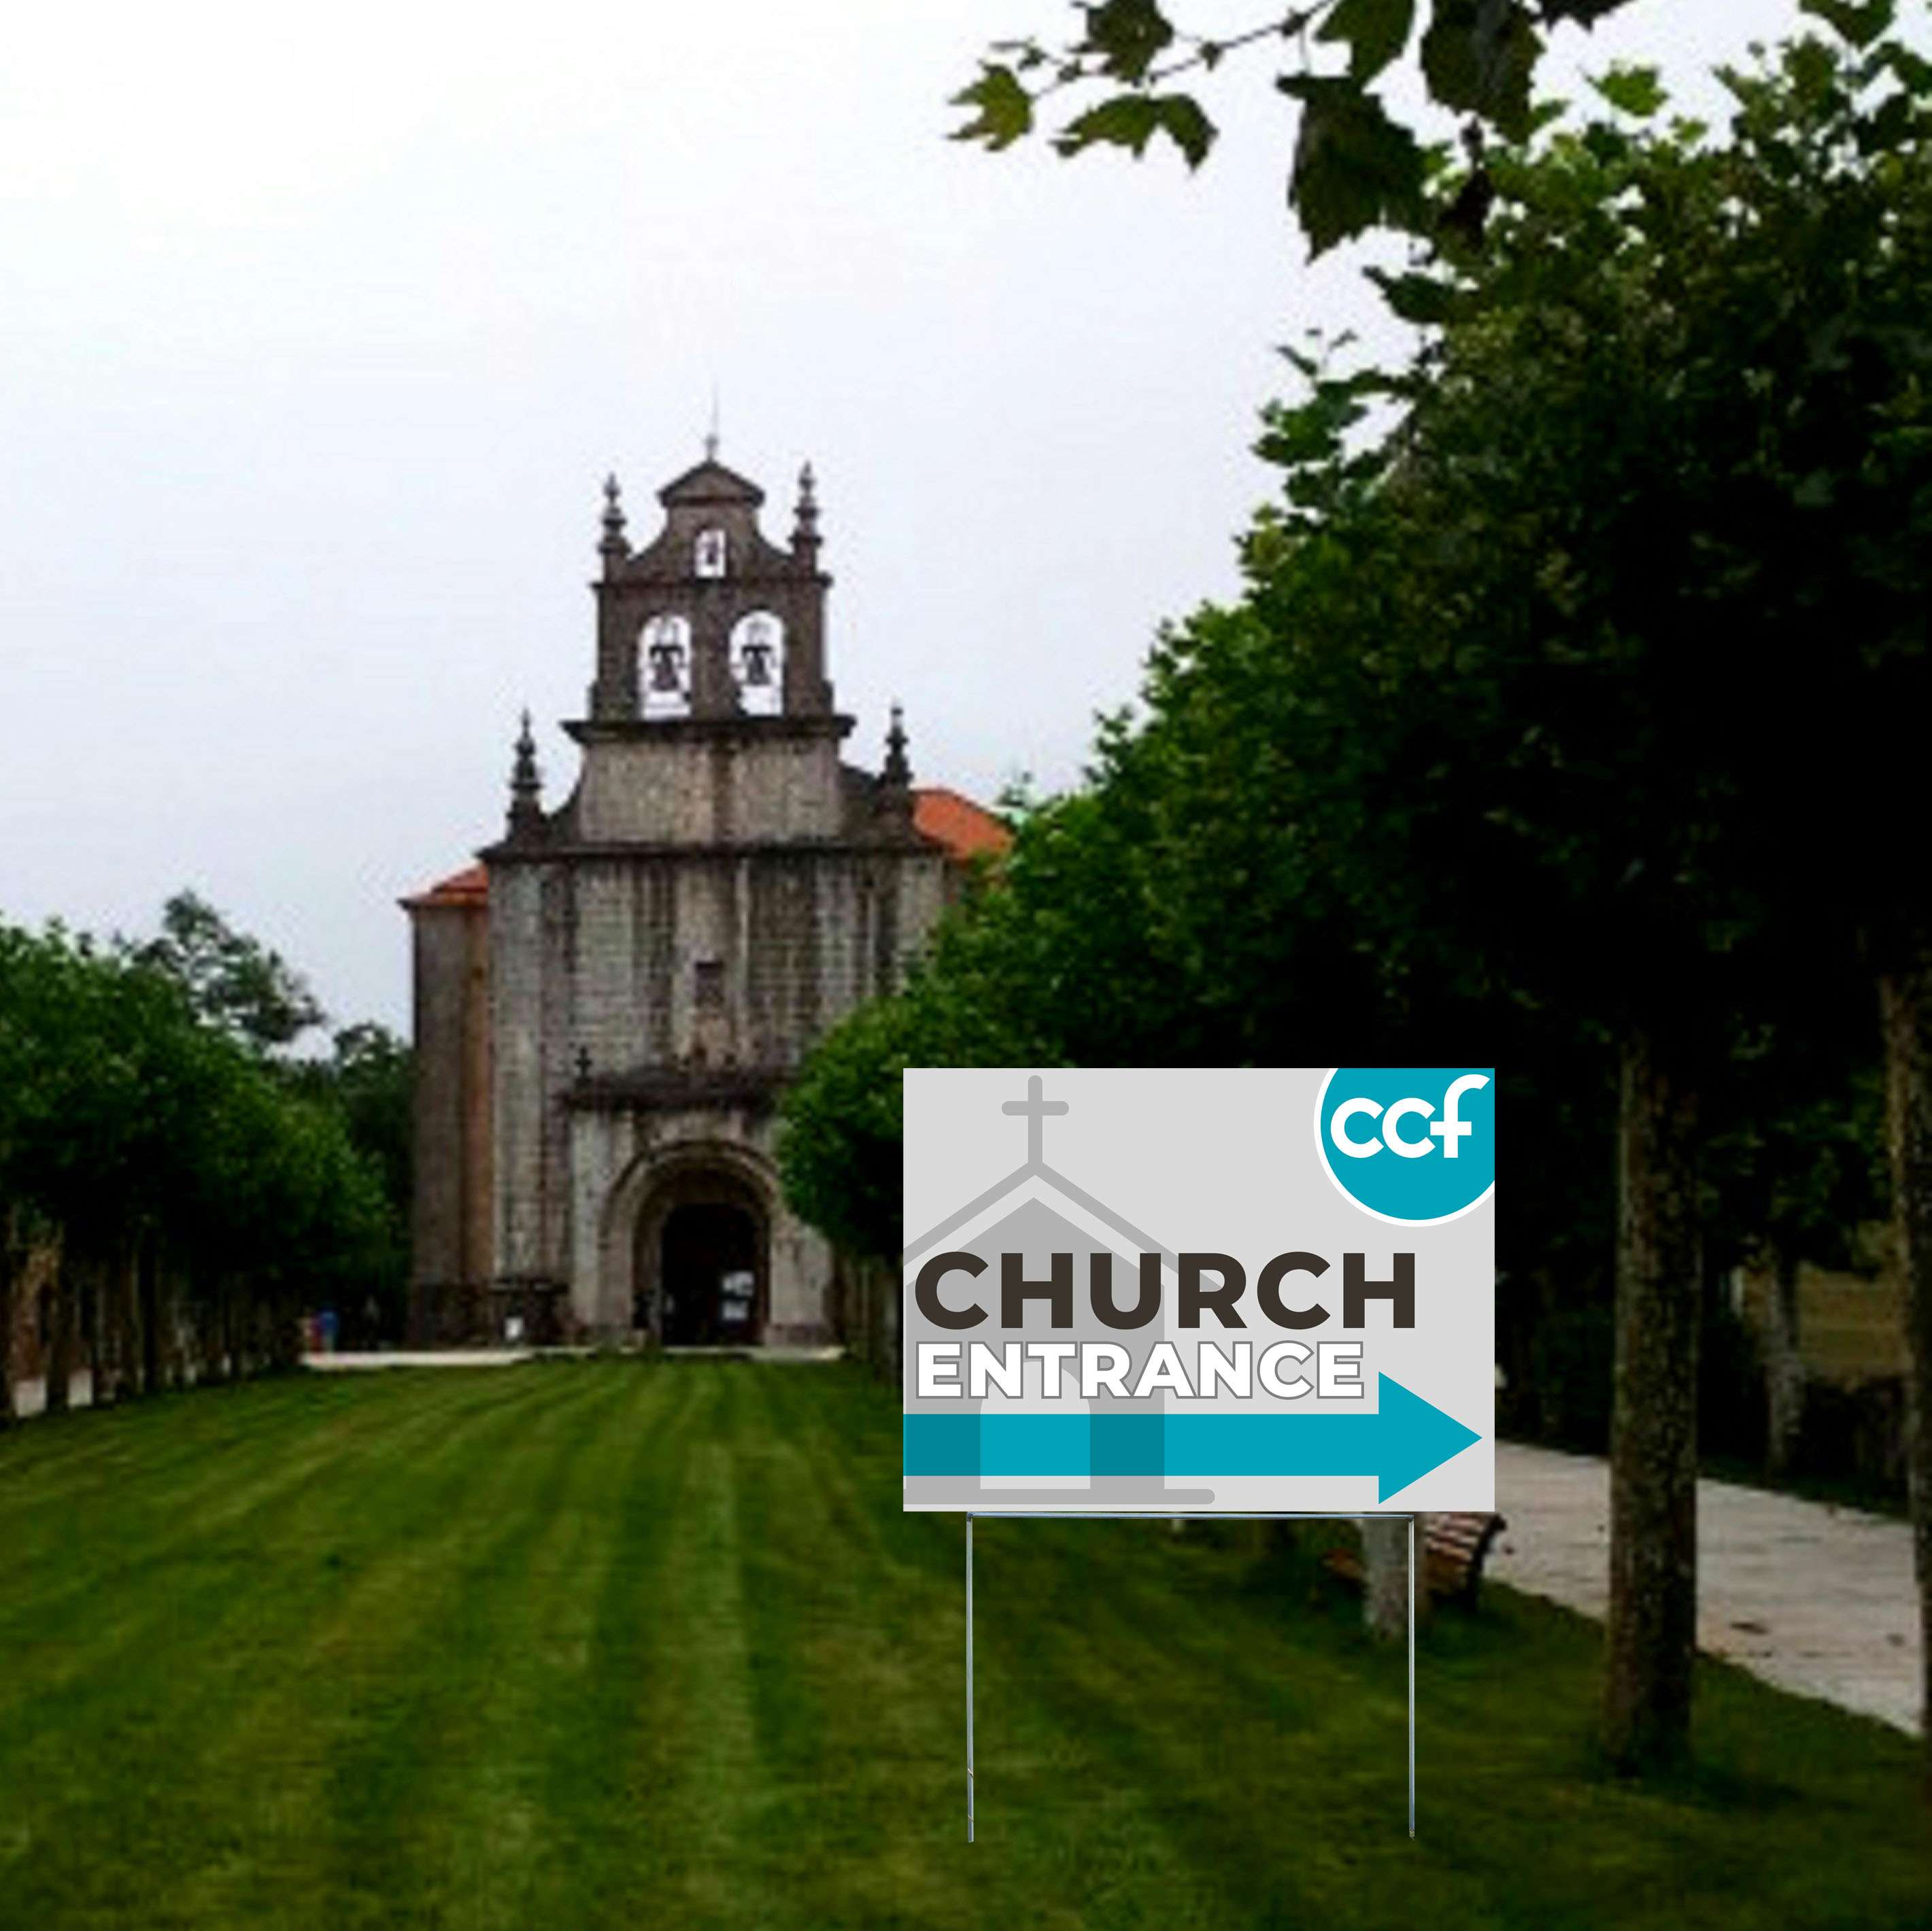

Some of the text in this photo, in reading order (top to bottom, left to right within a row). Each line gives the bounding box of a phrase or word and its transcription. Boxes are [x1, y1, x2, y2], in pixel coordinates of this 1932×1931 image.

[1330, 1074, 1491, 1159] ccf
[915, 1251, 1415, 1331] CHURCH
[915, 1340, 1365, 1399] ENTRANCE
